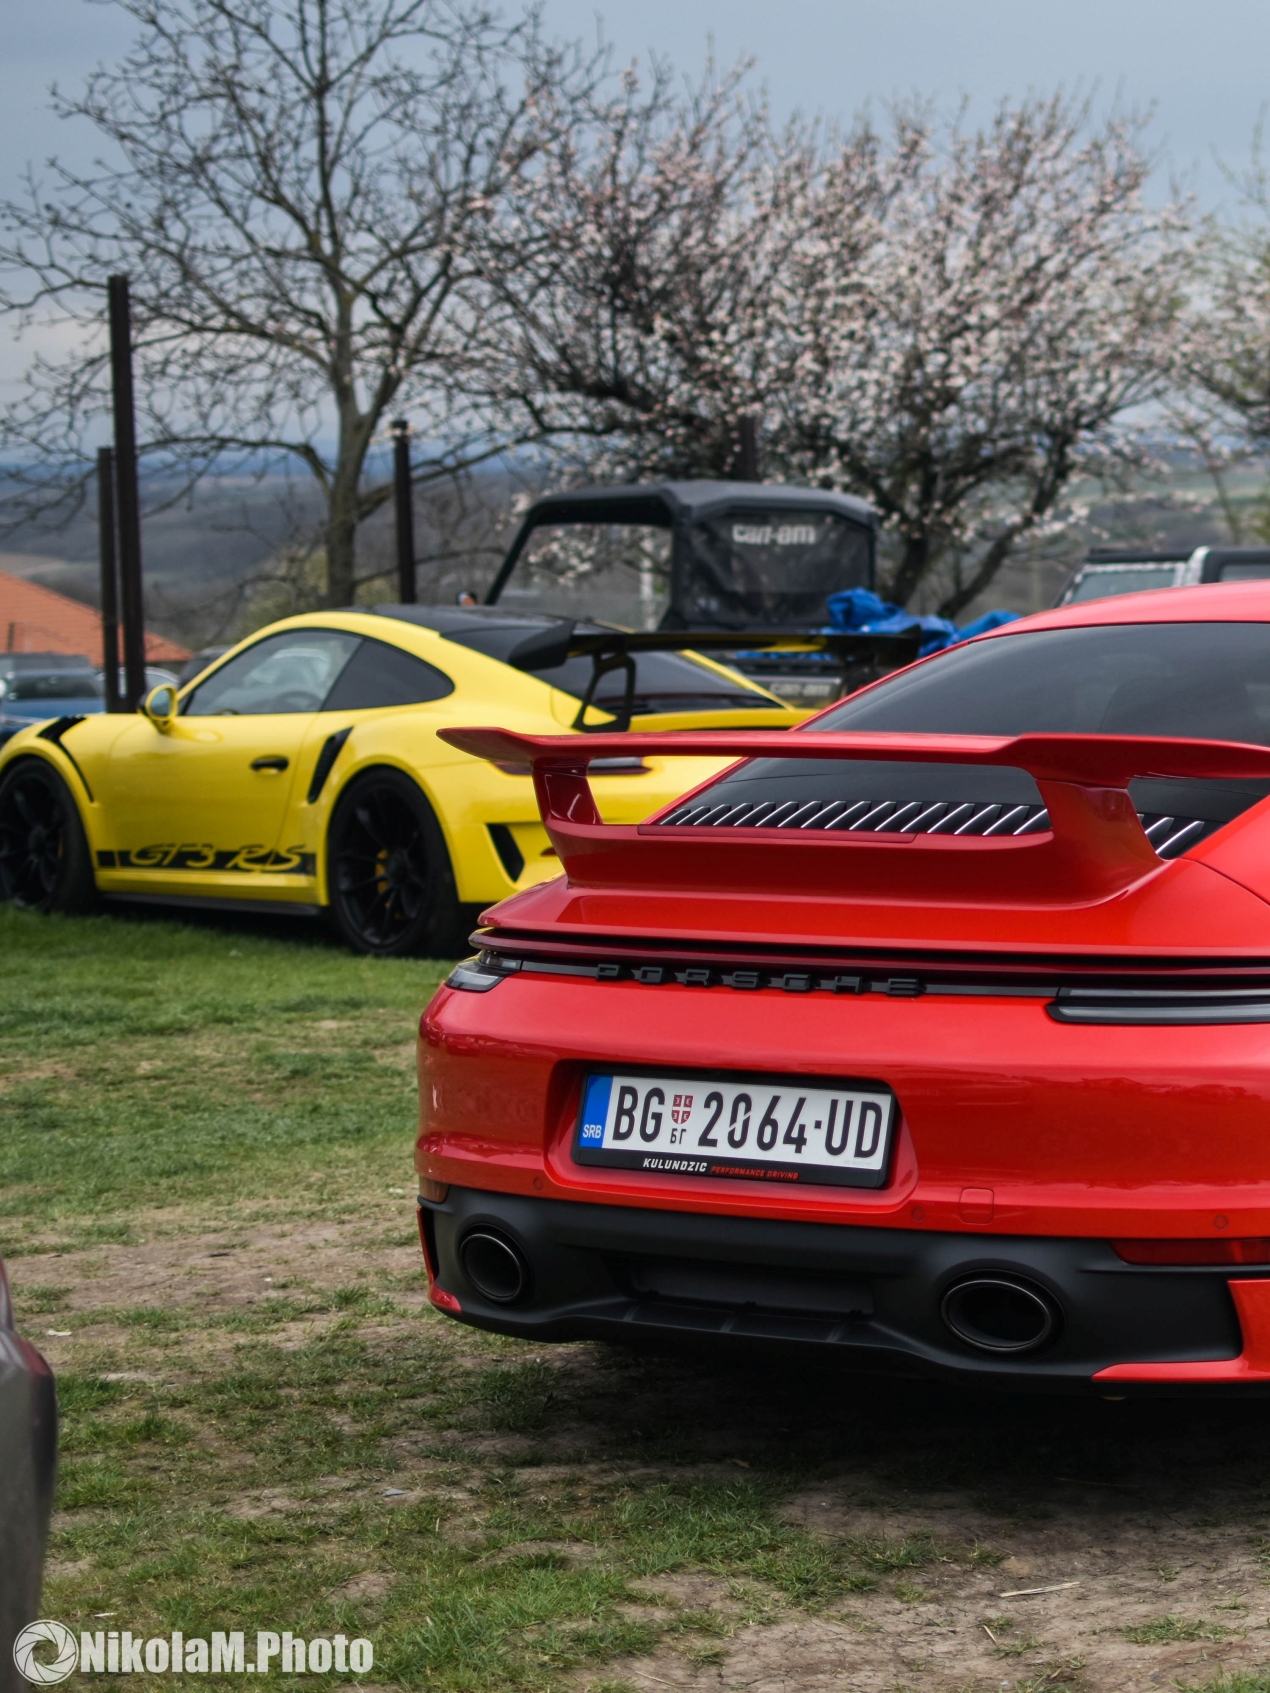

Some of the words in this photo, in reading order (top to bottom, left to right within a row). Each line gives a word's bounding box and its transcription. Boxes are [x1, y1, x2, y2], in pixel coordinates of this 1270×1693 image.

[225, 844, 306, 873] RS
[595, 963, 921, 997] PORSCHE
[612, 1085, 666, 1143] BG
[582, 1124, 602, 1139] SRB
[643, 1158, 708, 1172] KULUNDZIC
[711, 1166, 765, 1177] PERFORMANCE
[767, 1171, 799, 1179] DRIVING
